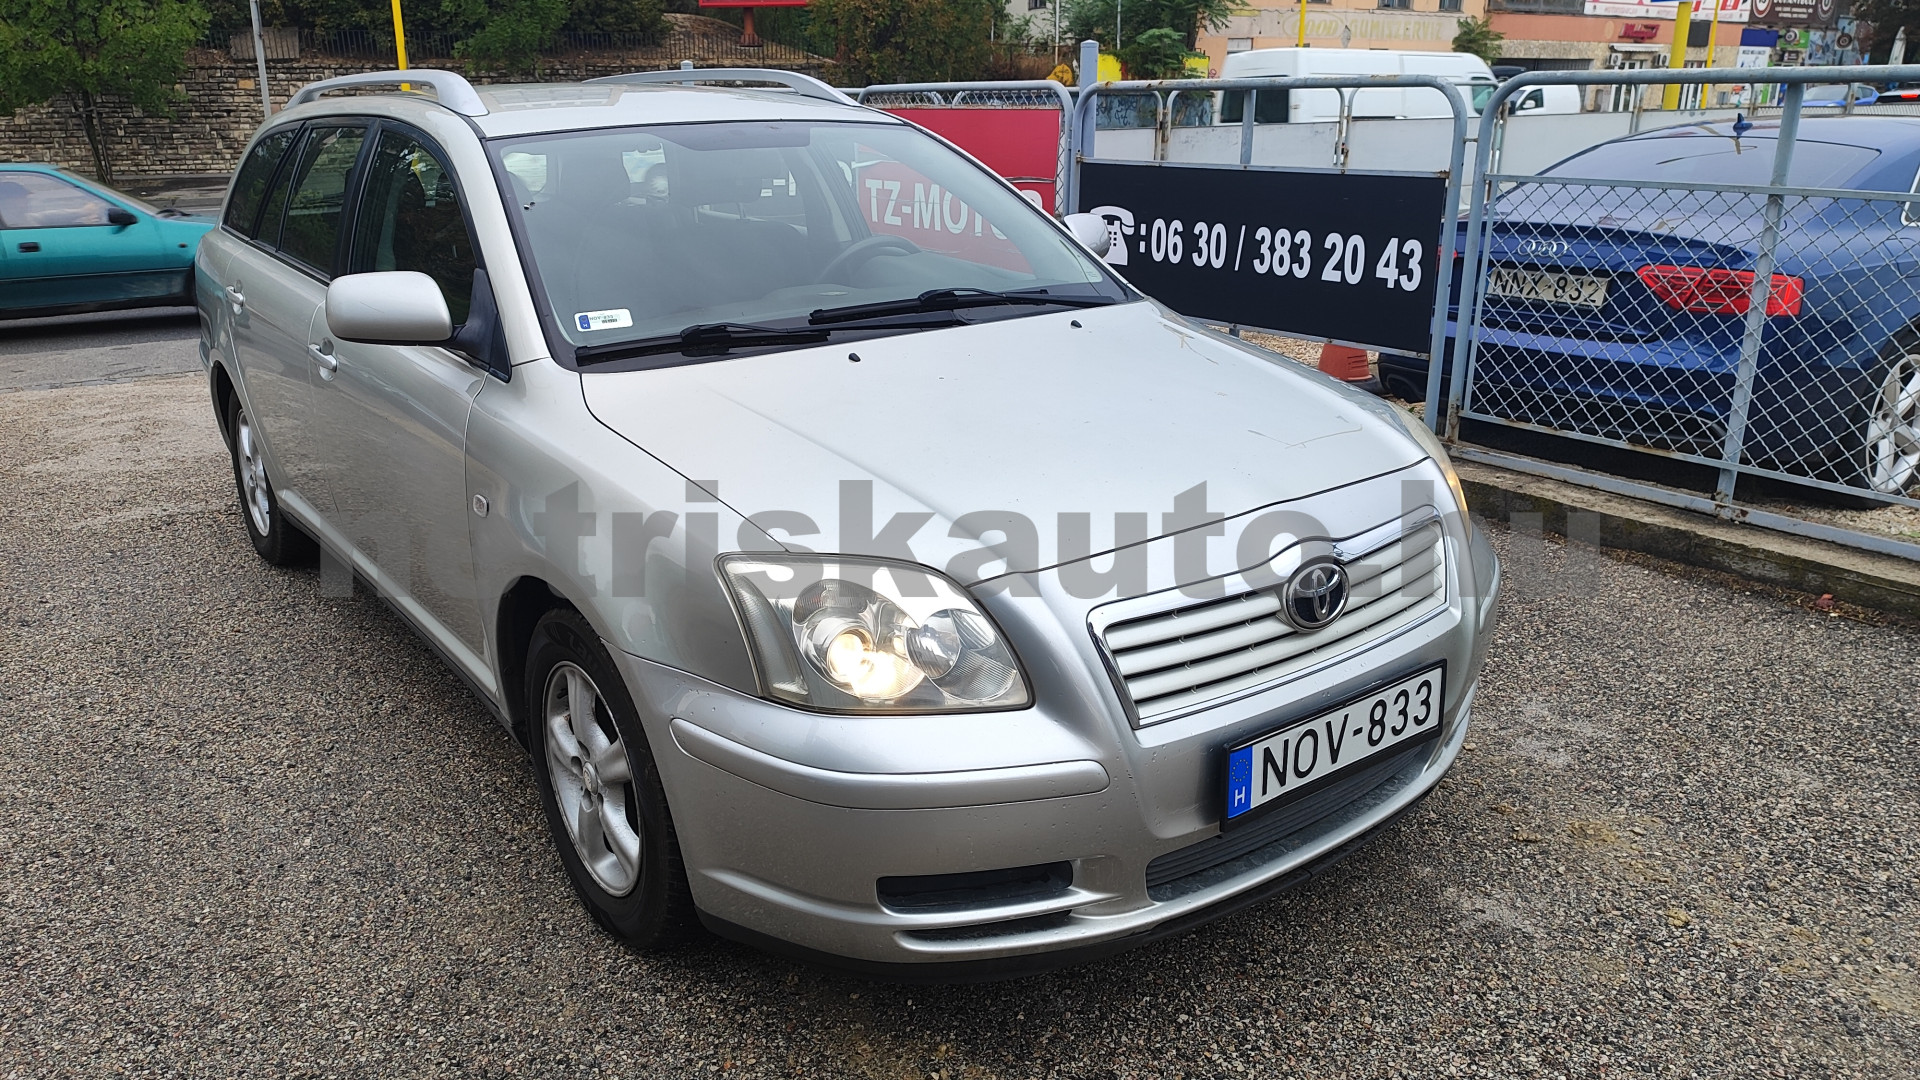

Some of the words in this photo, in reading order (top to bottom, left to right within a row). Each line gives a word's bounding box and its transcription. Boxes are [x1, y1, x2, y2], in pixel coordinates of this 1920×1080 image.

[1192, 221, 1227, 269] 30
[1252, 226, 1312, 279] 383
[1321, 232, 1366, 285] 20
[1375, 237, 1424, 292] 43
[1493, 266, 1597, 303] NNX-832
[1262, 679, 1433, 797] NOV-833
[1234, 785, 1246, 807] H
